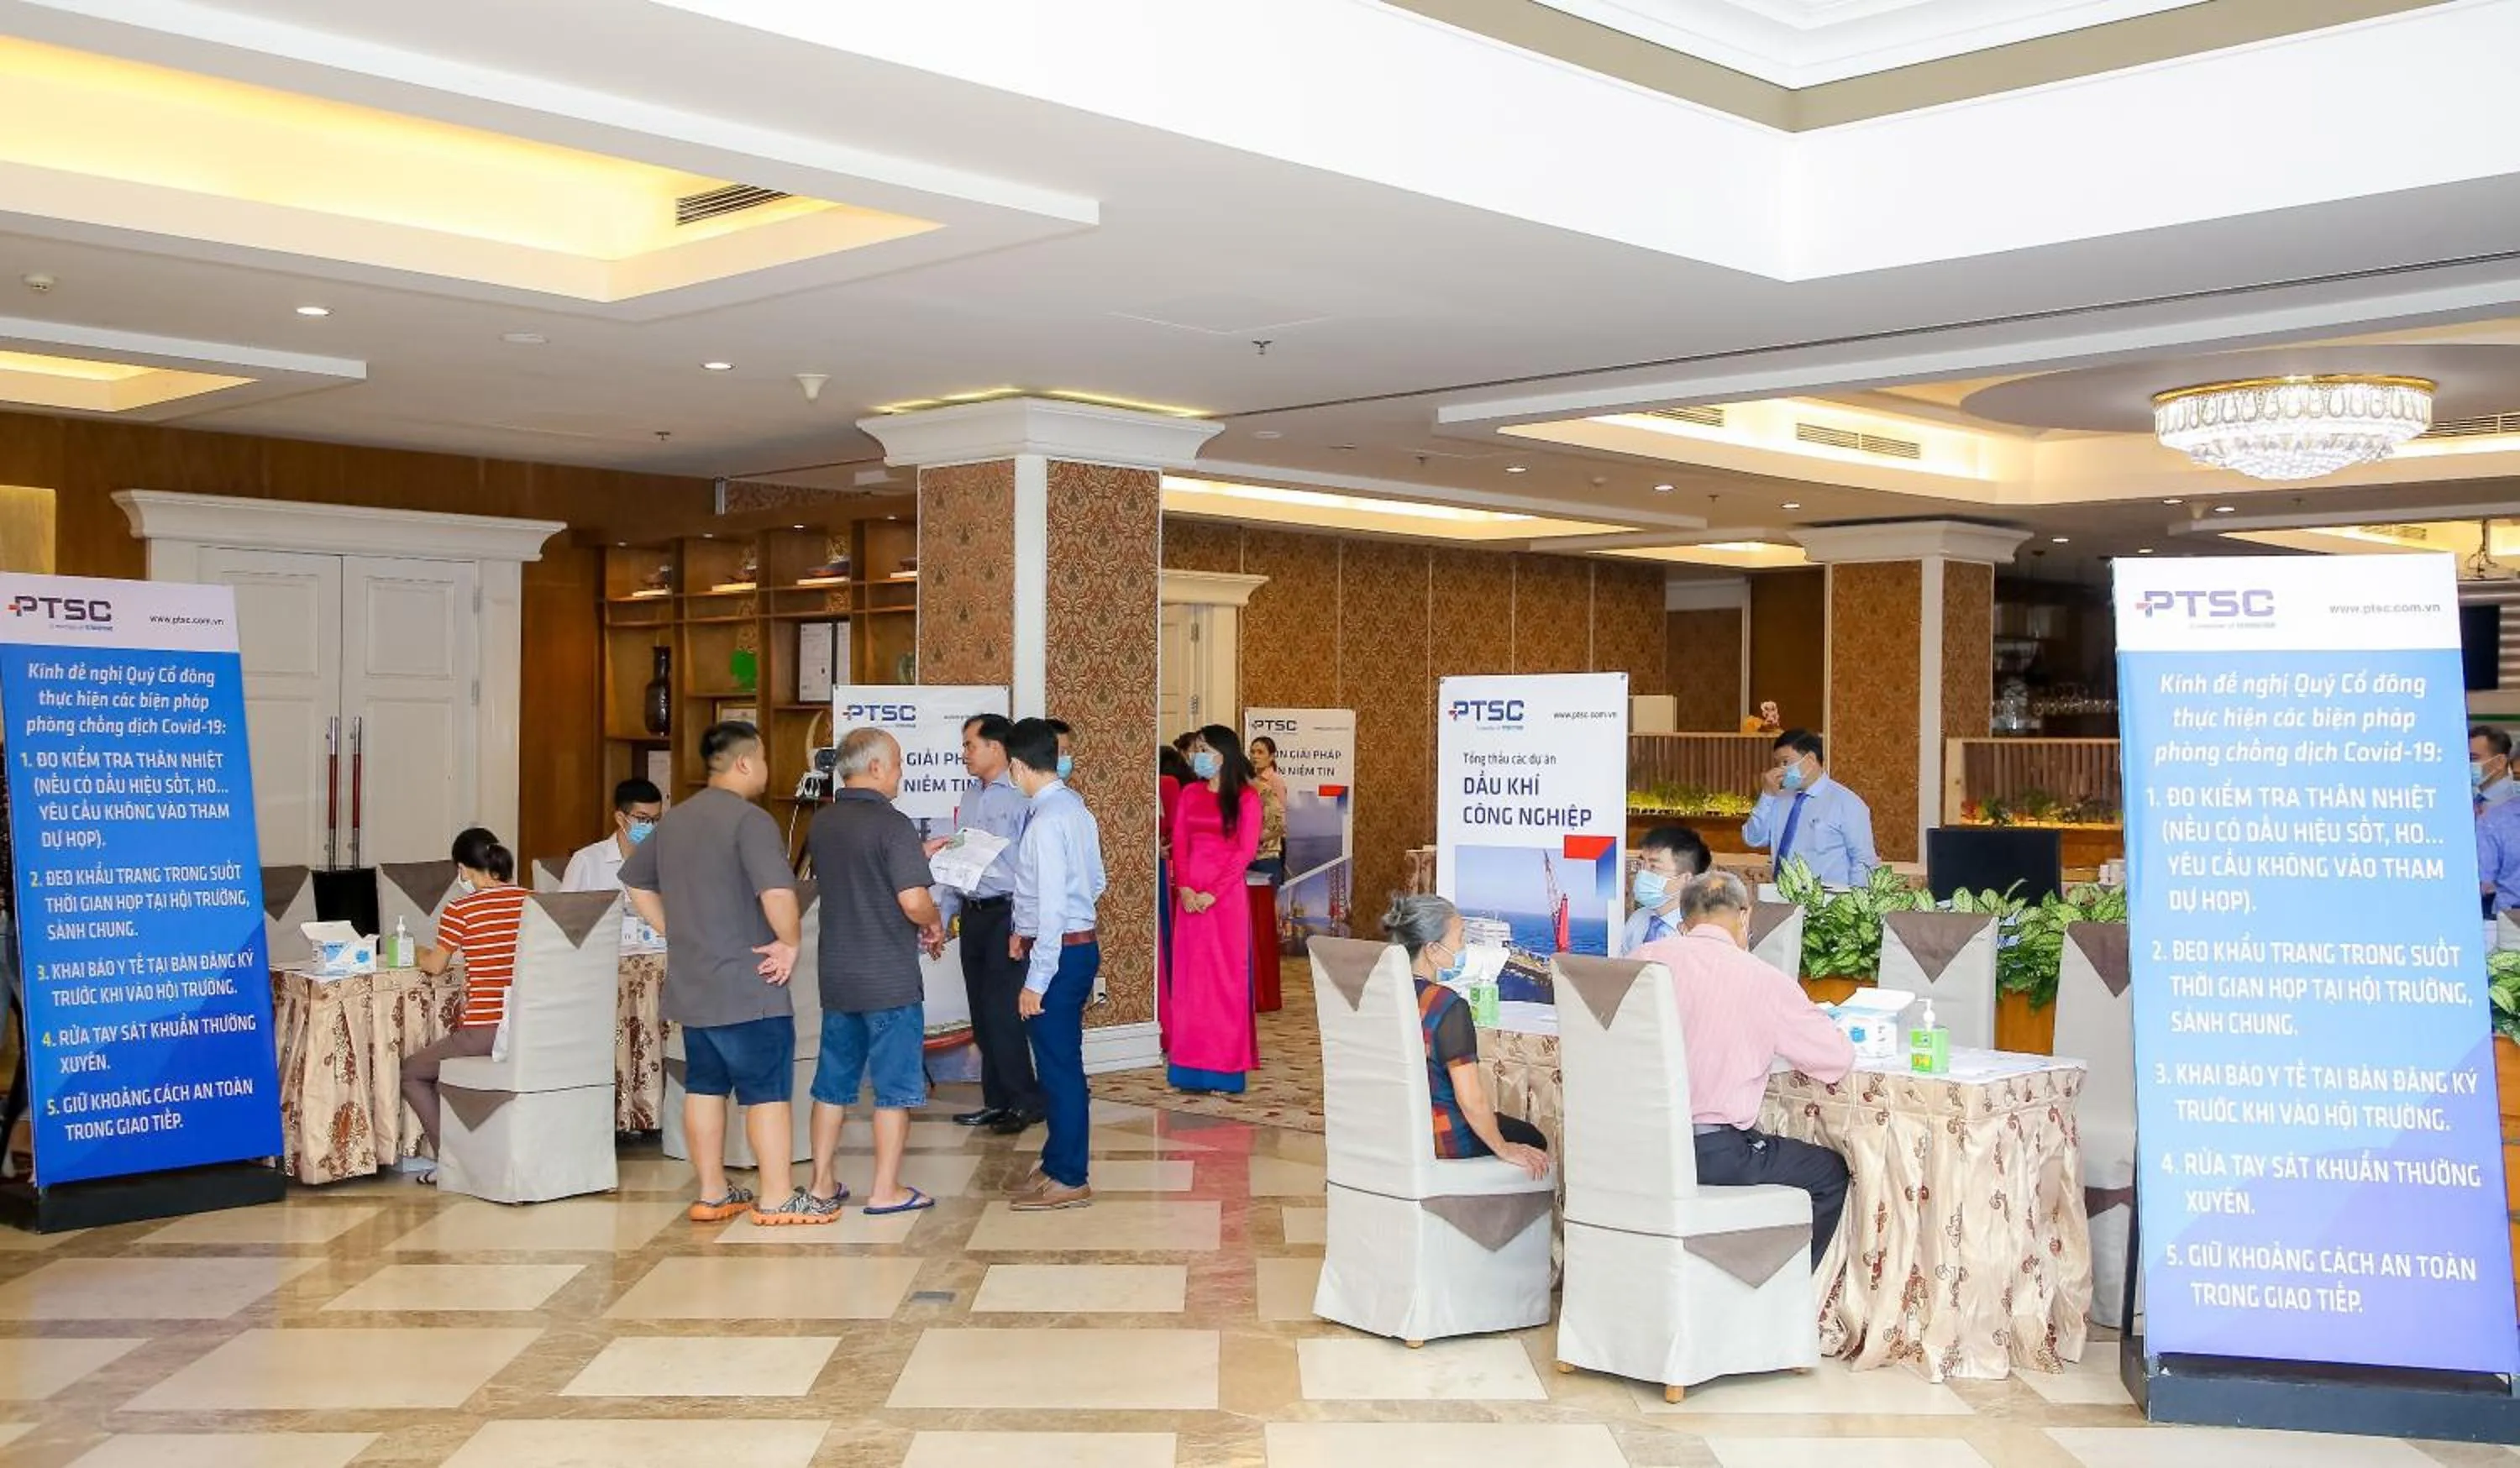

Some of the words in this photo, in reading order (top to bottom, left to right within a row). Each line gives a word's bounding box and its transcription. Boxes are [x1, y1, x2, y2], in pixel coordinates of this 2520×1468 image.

[8, 595, 112, 622] PTSC
[2135, 590, 2275, 618] PTSC
[2329, 602, 2441, 616] www.ptsc.com.vn
[29, 663, 65, 679] Kính
[90, 665, 123, 685] nghị
[158, 665, 176, 683] Cổ
[179, 668, 216, 689] đông
[2160, 673, 2208, 694] Kính
[2241, 673, 2289, 700] nghị
[2340, 668, 2367, 694] Cổ
[2372, 673, 2428, 699] đông
[39, 689, 74, 706] thực
[76, 690, 109, 710] hiện
[139, 692, 171, 711] biện
[843, 705, 916, 721] PTSC
[1448, 700, 1525, 721] PTSC
[128, 717, 159, 737] dịch
[161, 718, 227, 735] Covid-19:
[1252, 720, 1297, 731] PTSC
[2173, 706, 2218, 727] thực
[2223, 706, 2268, 727] hiện
[2312, 706, 2357, 728] biện
[20, 752, 33, 768] 1.
[36, 752, 59, 768] ĐO
[61, 745, 100, 768] KIỂM
[102, 752, 134, 768] TRA
[135, 749, 178, 768] THÂN
[181, 750, 224, 768] NHIỆT
[2294, 740, 2339, 766] dịch
[2344, 740, 2444, 763] Covid-19:
[129, 775, 162, 794] HIỆU
[1317, 767, 1335, 777] TIN
[1508, 773, 1541, 796] KHÍ
[2145, 787, 2160, 807] 1.
[2166, 786, 2196, 807] ĐO
[2200, 778, 2253, 807] KIỂM
[2257, 787, 2301, 808] TRA
[2304, 782, 2367, 809] THÂN
[2371, 783, 2437, 810] NHIỆT
[39, 801, 69, 821] YÊU
[103, 801, 155, 821] KHÔNG
[189, 804, 230, 819] THAM
[1463, 802, 1513, 826] CÔNG
[1519, 804, 1593, 831] NGHIỆP
[41, 829, 63, 851] DỰ
[2292, 817, 2341, 843] HIỆU
[29, 871, 44, 888] 2.
[45, 869, 74, 886] ĐEO
[116, 868, 161, 884] TRANG
[163, 866, 207, 883] TRONG
[2167, 851, 2206, 876] YÊU
[2256, 852, 2329, 878] KHÔNG
[2381, 857, 2445, 879] THAM
[2168, 886, 2197, 915] DỰ
[2151, 940, 2168, 962] 2.
[2172, 940, 2209, 962] ĐEO
[2269, 941, 2335, 964] TRANG
[2339, 943, 2407, 967] TRONG
[2218, 976, 2264, 999] GIAN
[2268, 978, 2307, 1002] HỌP
[2347, 974, 2381, 1005] HỘI
[2227, 1011, 2299, 1036] CHUNG.
[2155, 1062, 2171, 1084] 3.
[2176, 1063, 2221, 1085] KHAI
[2266, 1065, 2281, 1087] Y
[2451, 1067, 2479, 1094] KÝ
[47, 1098, 60, 1116] 5.
[63, 1092, 88, 1114] GIỮ
[193, 1083, 213, 1099] AN
[2242, 1101, 2276, 1124] KHI
[2323, 1099, 2358, 1130] HỘI
[2160, 1152, 2179, 1174] 4.
[2231, 1155, 2265, 1177] TAY
[2166, 1244, 2183, 1266] 5.
[2188, 1240, 2222, 1267] GIỮ
[2380, 1252, 2412, 1277] AN
[2189, 1282, 2260, 1308] TRONG
[2264, 1285, 2312, 1311] GIAO
